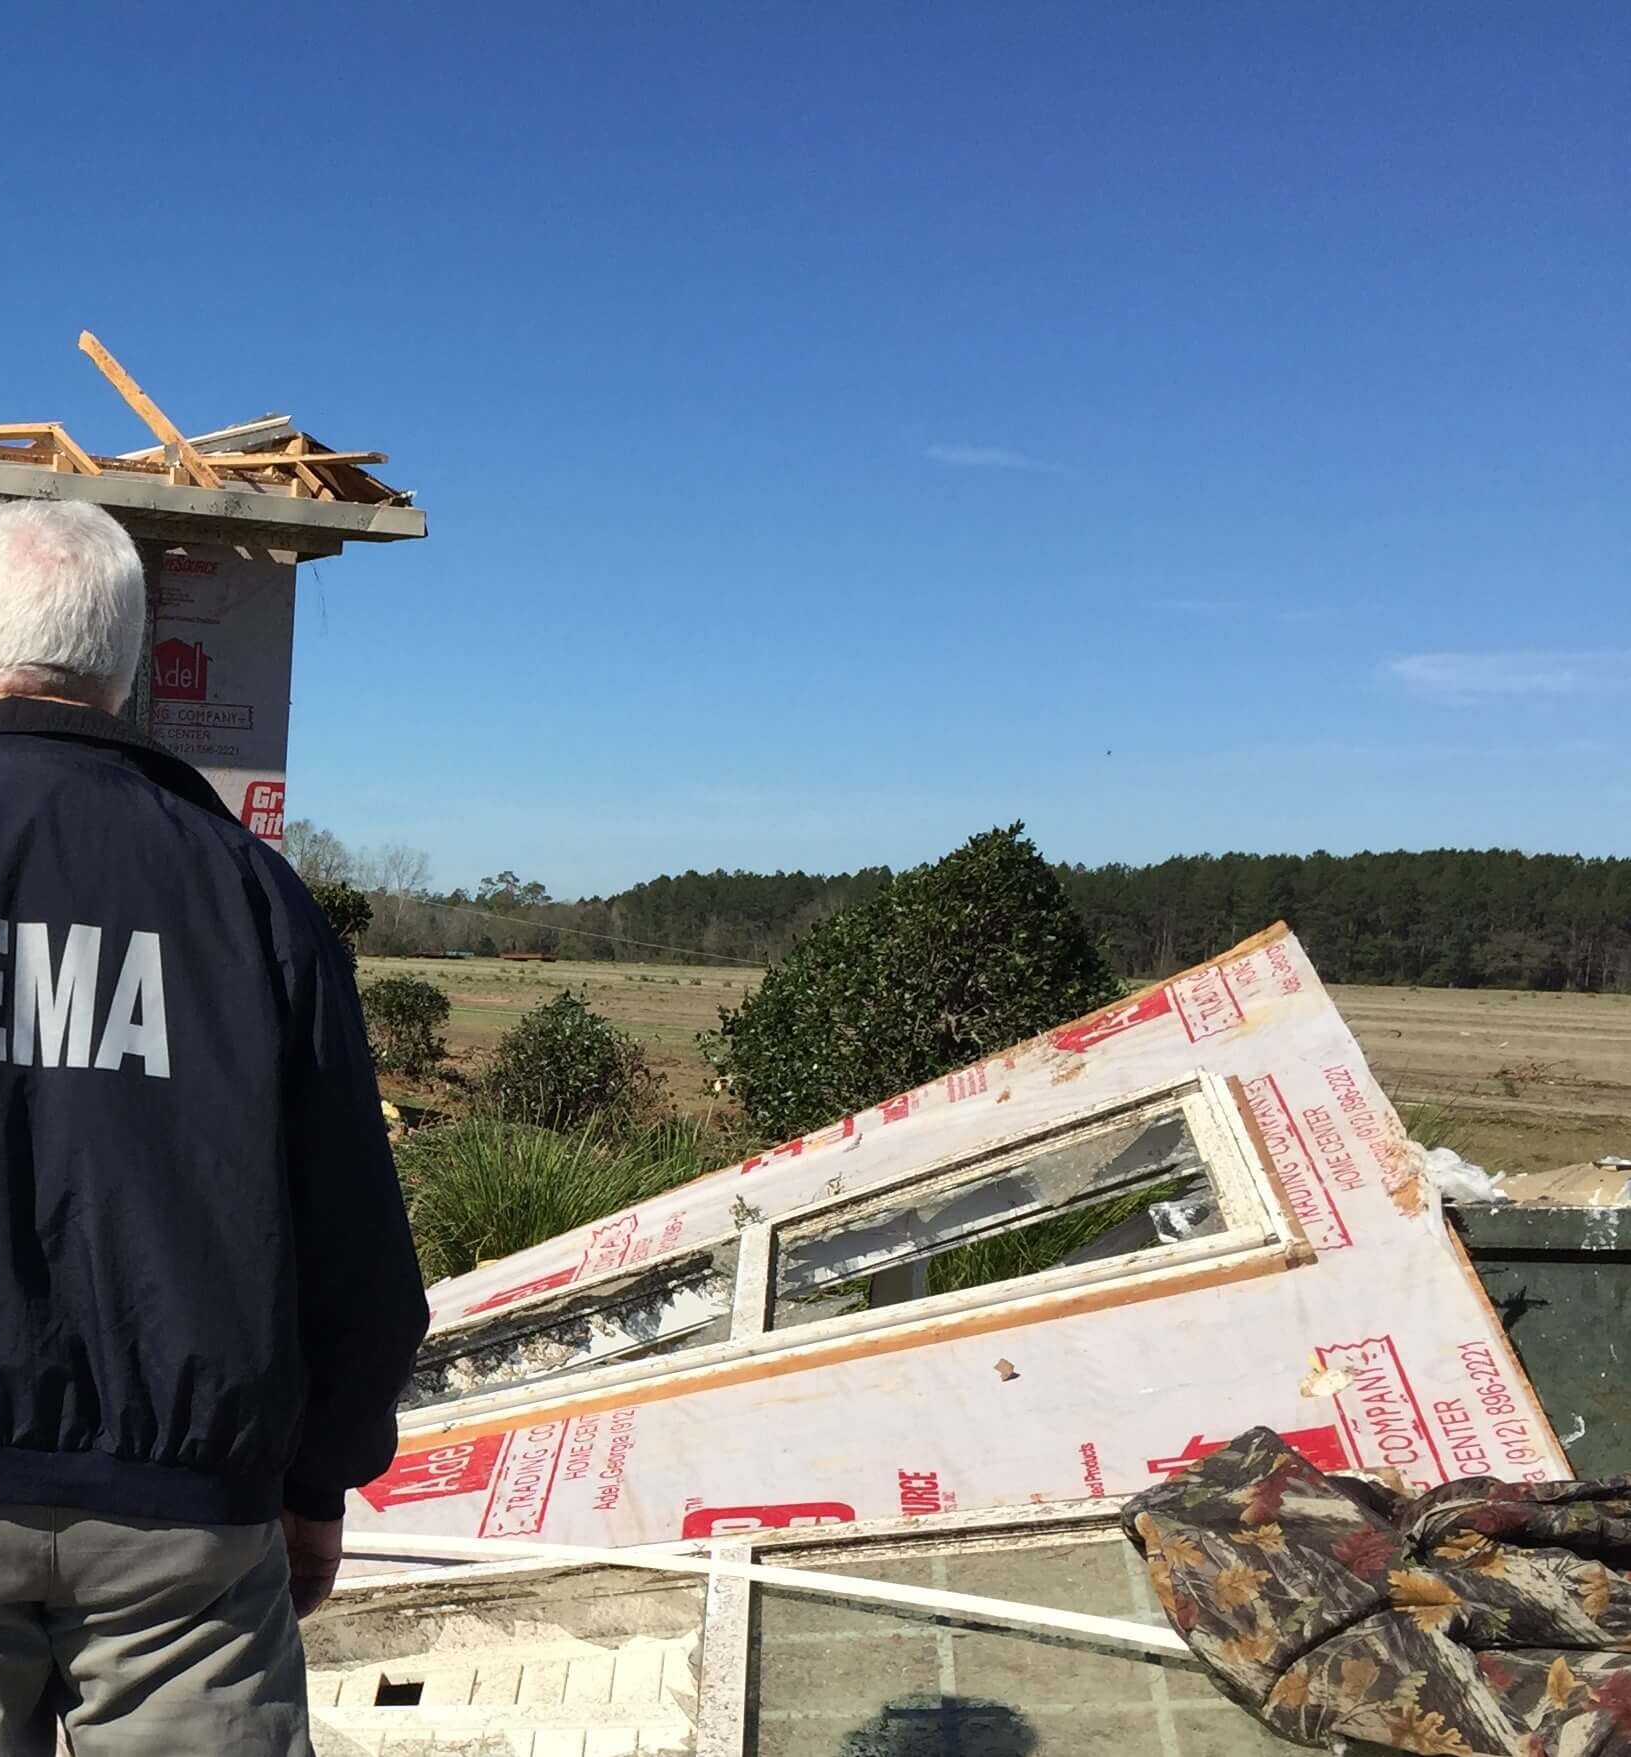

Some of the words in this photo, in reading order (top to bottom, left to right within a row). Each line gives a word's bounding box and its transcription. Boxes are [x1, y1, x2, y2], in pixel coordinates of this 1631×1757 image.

[167, 727, 211, 741] CENTER
[177, 709, 241, 725] COMPANY
[252, 786, 284, 809] Gr
[249, 812, 283, 836] Rit
[1266, 943, 1292, 977] Georg
[1321, 1063, 1368, 1112] 896-2221
[1302, 1104, 1345, 1153] CENTER
[1328, 1152, 1366, 1192] HOME
[1456, 1340, 1516, 1416] 896-2221
[572, 1413, 598, 1443] CENT
[1353, 1365, 1418, 1465] COMPANY
[599, 1435, 634, 1479] Georgia
[1433, 1398, 1491, 1475] CENTER
[1491, 1419, 1544, 1466] (912)
[389, 1445, 475, 1497] Ade
[505, 1448, 550, 1513] TRADING
[528, 1423, 556, 1442] CO
[565, 1445, 592, 1481] HOME
[1078, 1442, 1102, 1482] Products
[685, 1497, 704, 1511] TM
[899, 1471, 942, 1514] URCE
